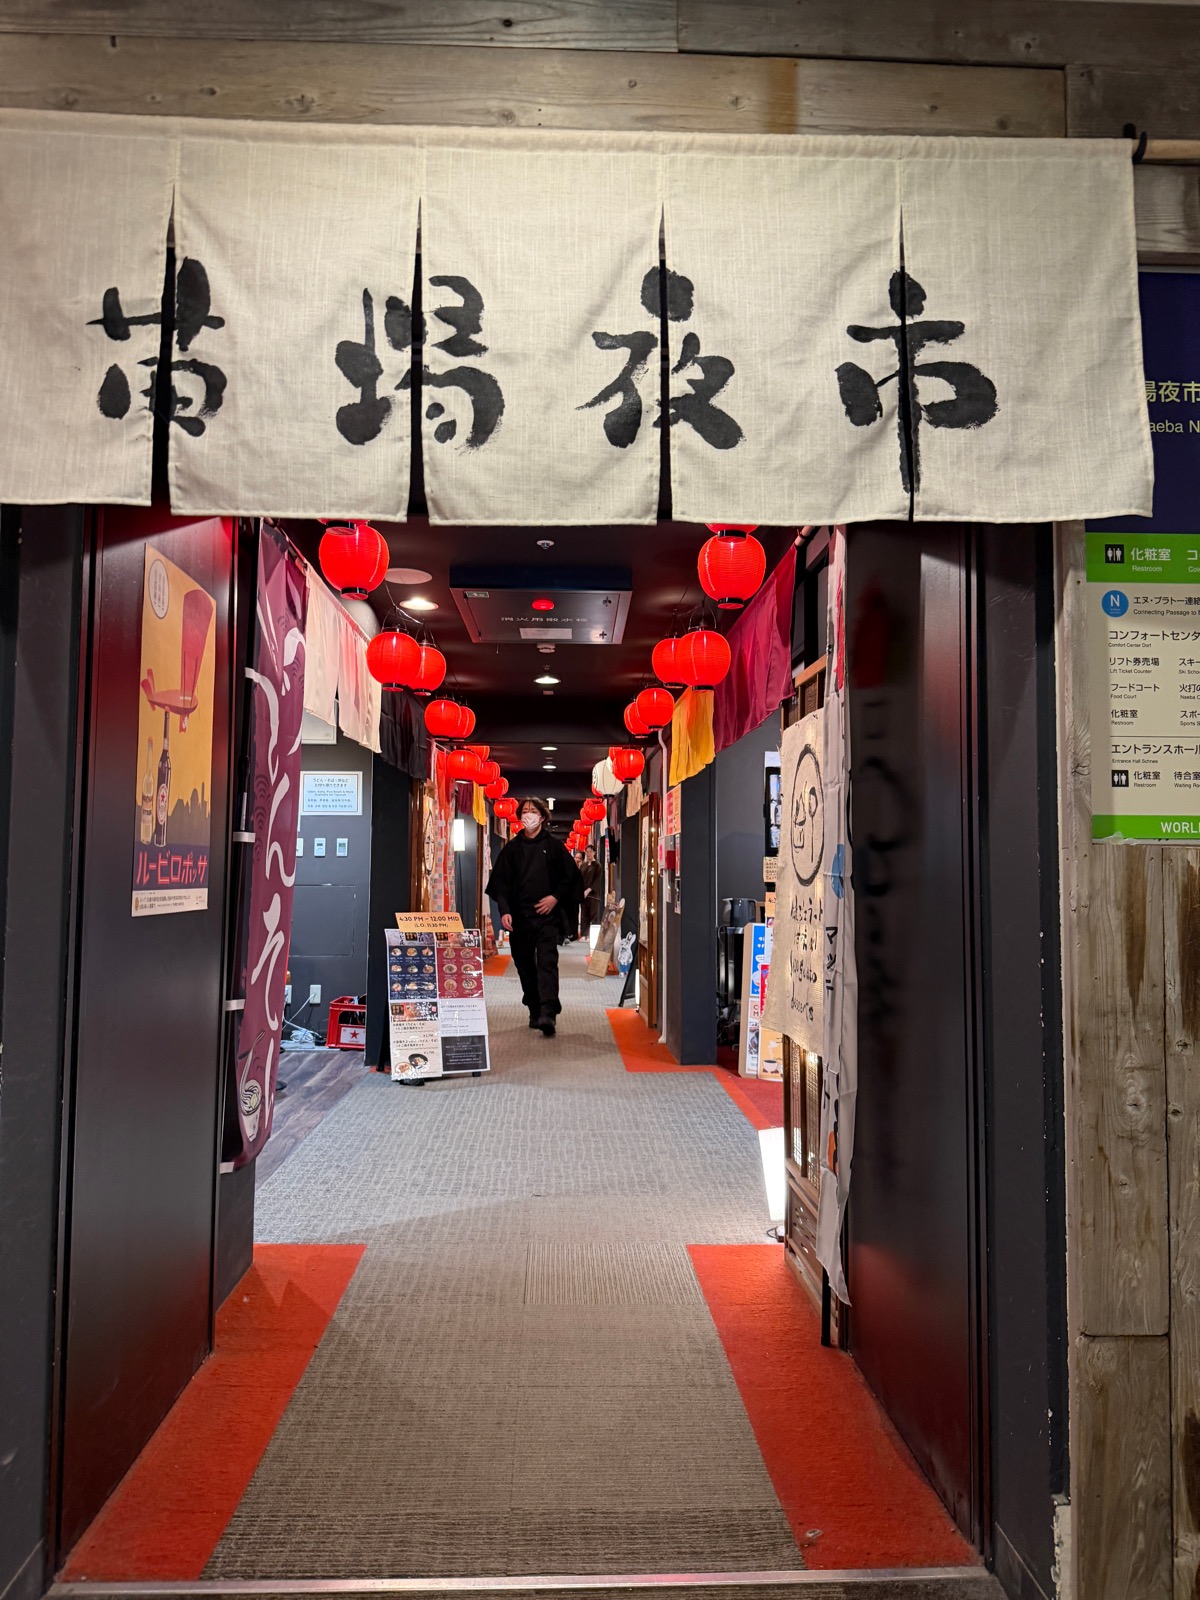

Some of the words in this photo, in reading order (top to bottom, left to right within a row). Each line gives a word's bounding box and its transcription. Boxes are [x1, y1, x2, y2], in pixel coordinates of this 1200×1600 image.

[1130, 547, 1171, 561] 化粧室
[1110, 594, 1120, 607] N
[1109, 657, 1160, 667] リフト券売場
[1111, 683, 1160, 692] フードコート
[1110, 709, 1139, 719] 化粧室
[1133, 771, 1161, 780] 化粧室
[1174, 771, 1200, 781] 待合室
[1160, 821, 1200, 833] WORL
